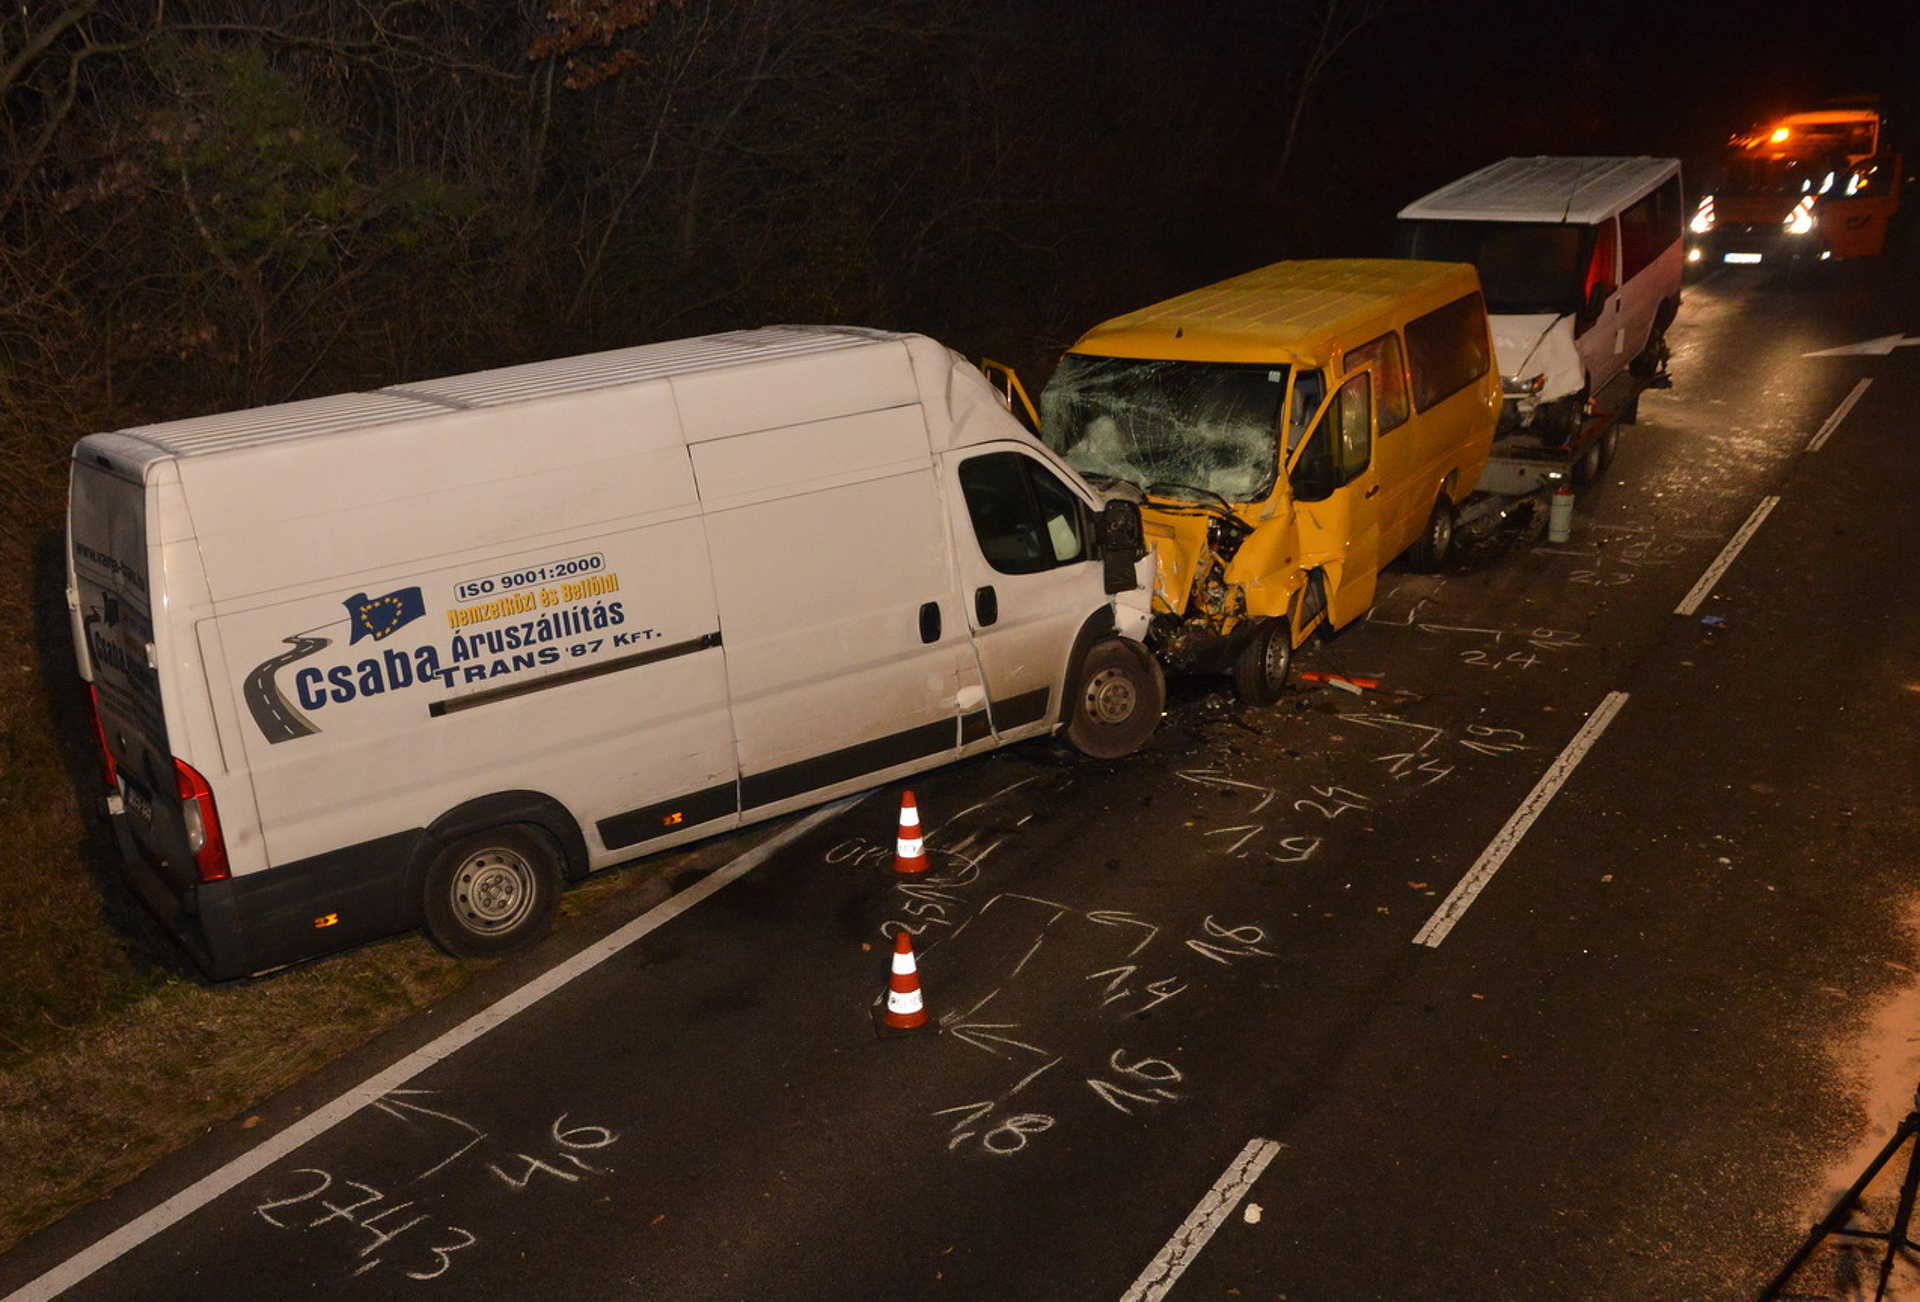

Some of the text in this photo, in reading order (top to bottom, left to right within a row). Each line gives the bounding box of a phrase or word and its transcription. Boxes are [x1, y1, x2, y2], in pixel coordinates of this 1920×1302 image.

[459, 556, 602, 599] ISO 9001:2000
[539, 586, 560, 609] és
[451, 601, 626, 665] Áruszállítás
[295, 645, 441, 711] Csaba
[435, 647, 562, 689] TRANS
